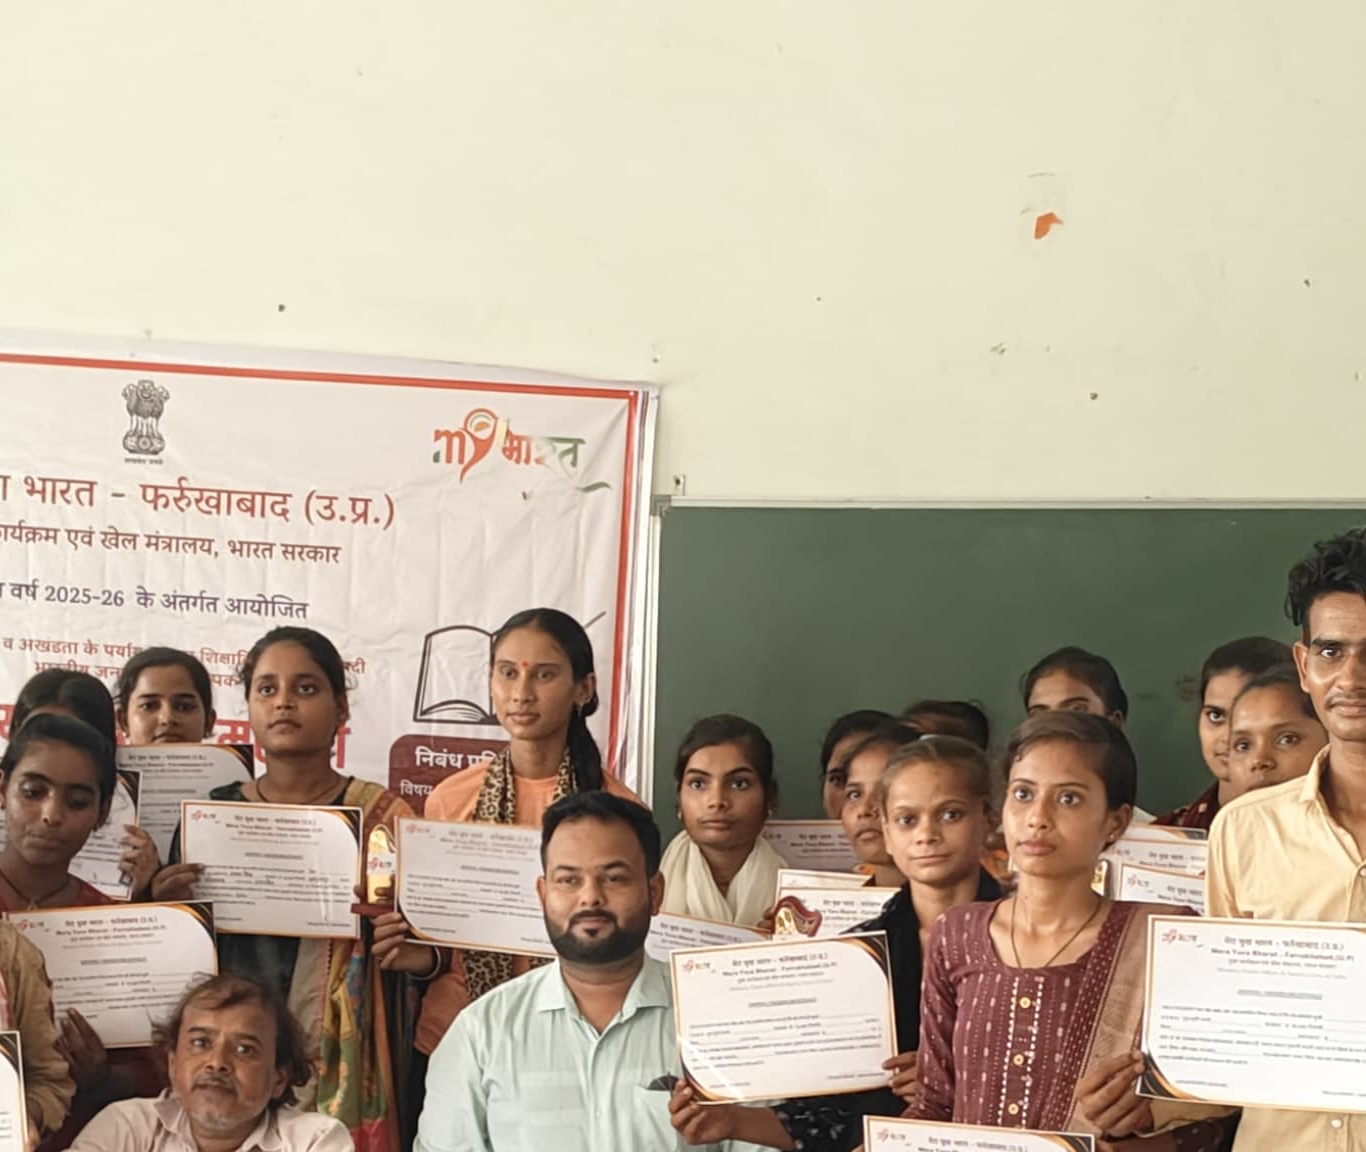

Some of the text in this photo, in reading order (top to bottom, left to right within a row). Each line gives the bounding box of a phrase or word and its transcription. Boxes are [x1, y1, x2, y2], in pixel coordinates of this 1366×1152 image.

[23, 475, 98, 507] भारत
[138, 476, 293, 521] फर्रुखाबाद
[304, 490, 395, 530] (उ.प्र.)
[65, 525, 95, 550] एवं
[100, 525, 139, 551] खेल
[144, 531, 219, 558] मंत्रालय,
[227, 539, 275, 560] भारत
[281, 542, 342, 563] सरकार
[9, 578, 39, 600] वर्ष
[45, 585, 125, 607] 2025-26
[135, 586, 155, 608] के
[161, 589, 220, 613] अंतर्गत
[225, 594, 310, 620] आयोजित
[2, 636, 14, 650] व
[83, 639, 99, 655] के
[415, 745, 463, 768] निबंध
